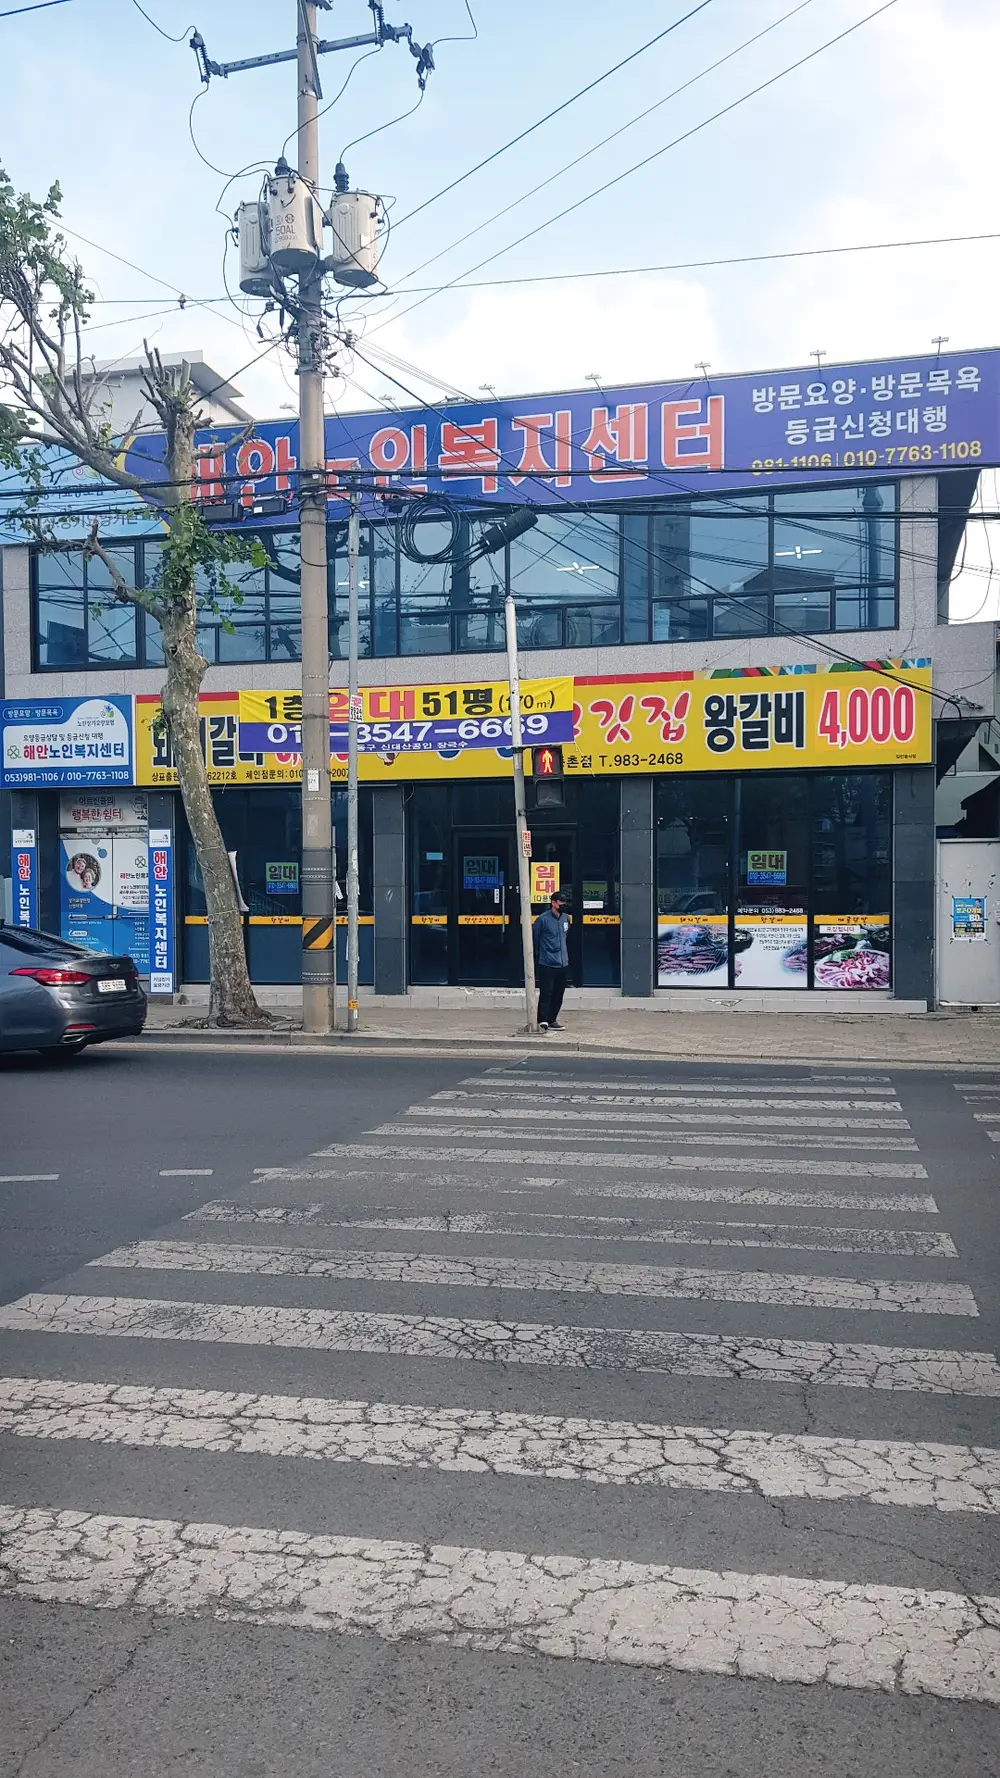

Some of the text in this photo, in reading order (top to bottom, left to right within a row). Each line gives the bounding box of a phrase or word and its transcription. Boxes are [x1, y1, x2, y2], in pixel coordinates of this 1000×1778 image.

[752, 366, 982, 413] 방문요양·방문목욕
[784, 405, 948, 446] 등급신청대행
[843, 440, 982, 467] 010-7763-1108
[422, 688, 493, 716] 51평
[267, 714, 549, 744] 01-3547-6669
[704, 685, 915, 754] 왕갈비 4,000
[23, 743, 125, 760] 해안노인복지센터
[562, 754, 592, 769] 촌점
[4, 772, 59, 782] 053)981-1106
[66, 771, 129, 781] 010-7763-1108
[72, 808, 123, 820] 행복한 쉼터
[18, 853, 31, 881] 해안
[154, 850, 168, 880] 해안
[269, 865, 297, 880] 임대
[751, 854, 785, 870] 임대
[535, 865, 556, 893] 임대
[19, 883, 31, 928] 노인복
[154, 884, 168, 969] 노인복지센터
